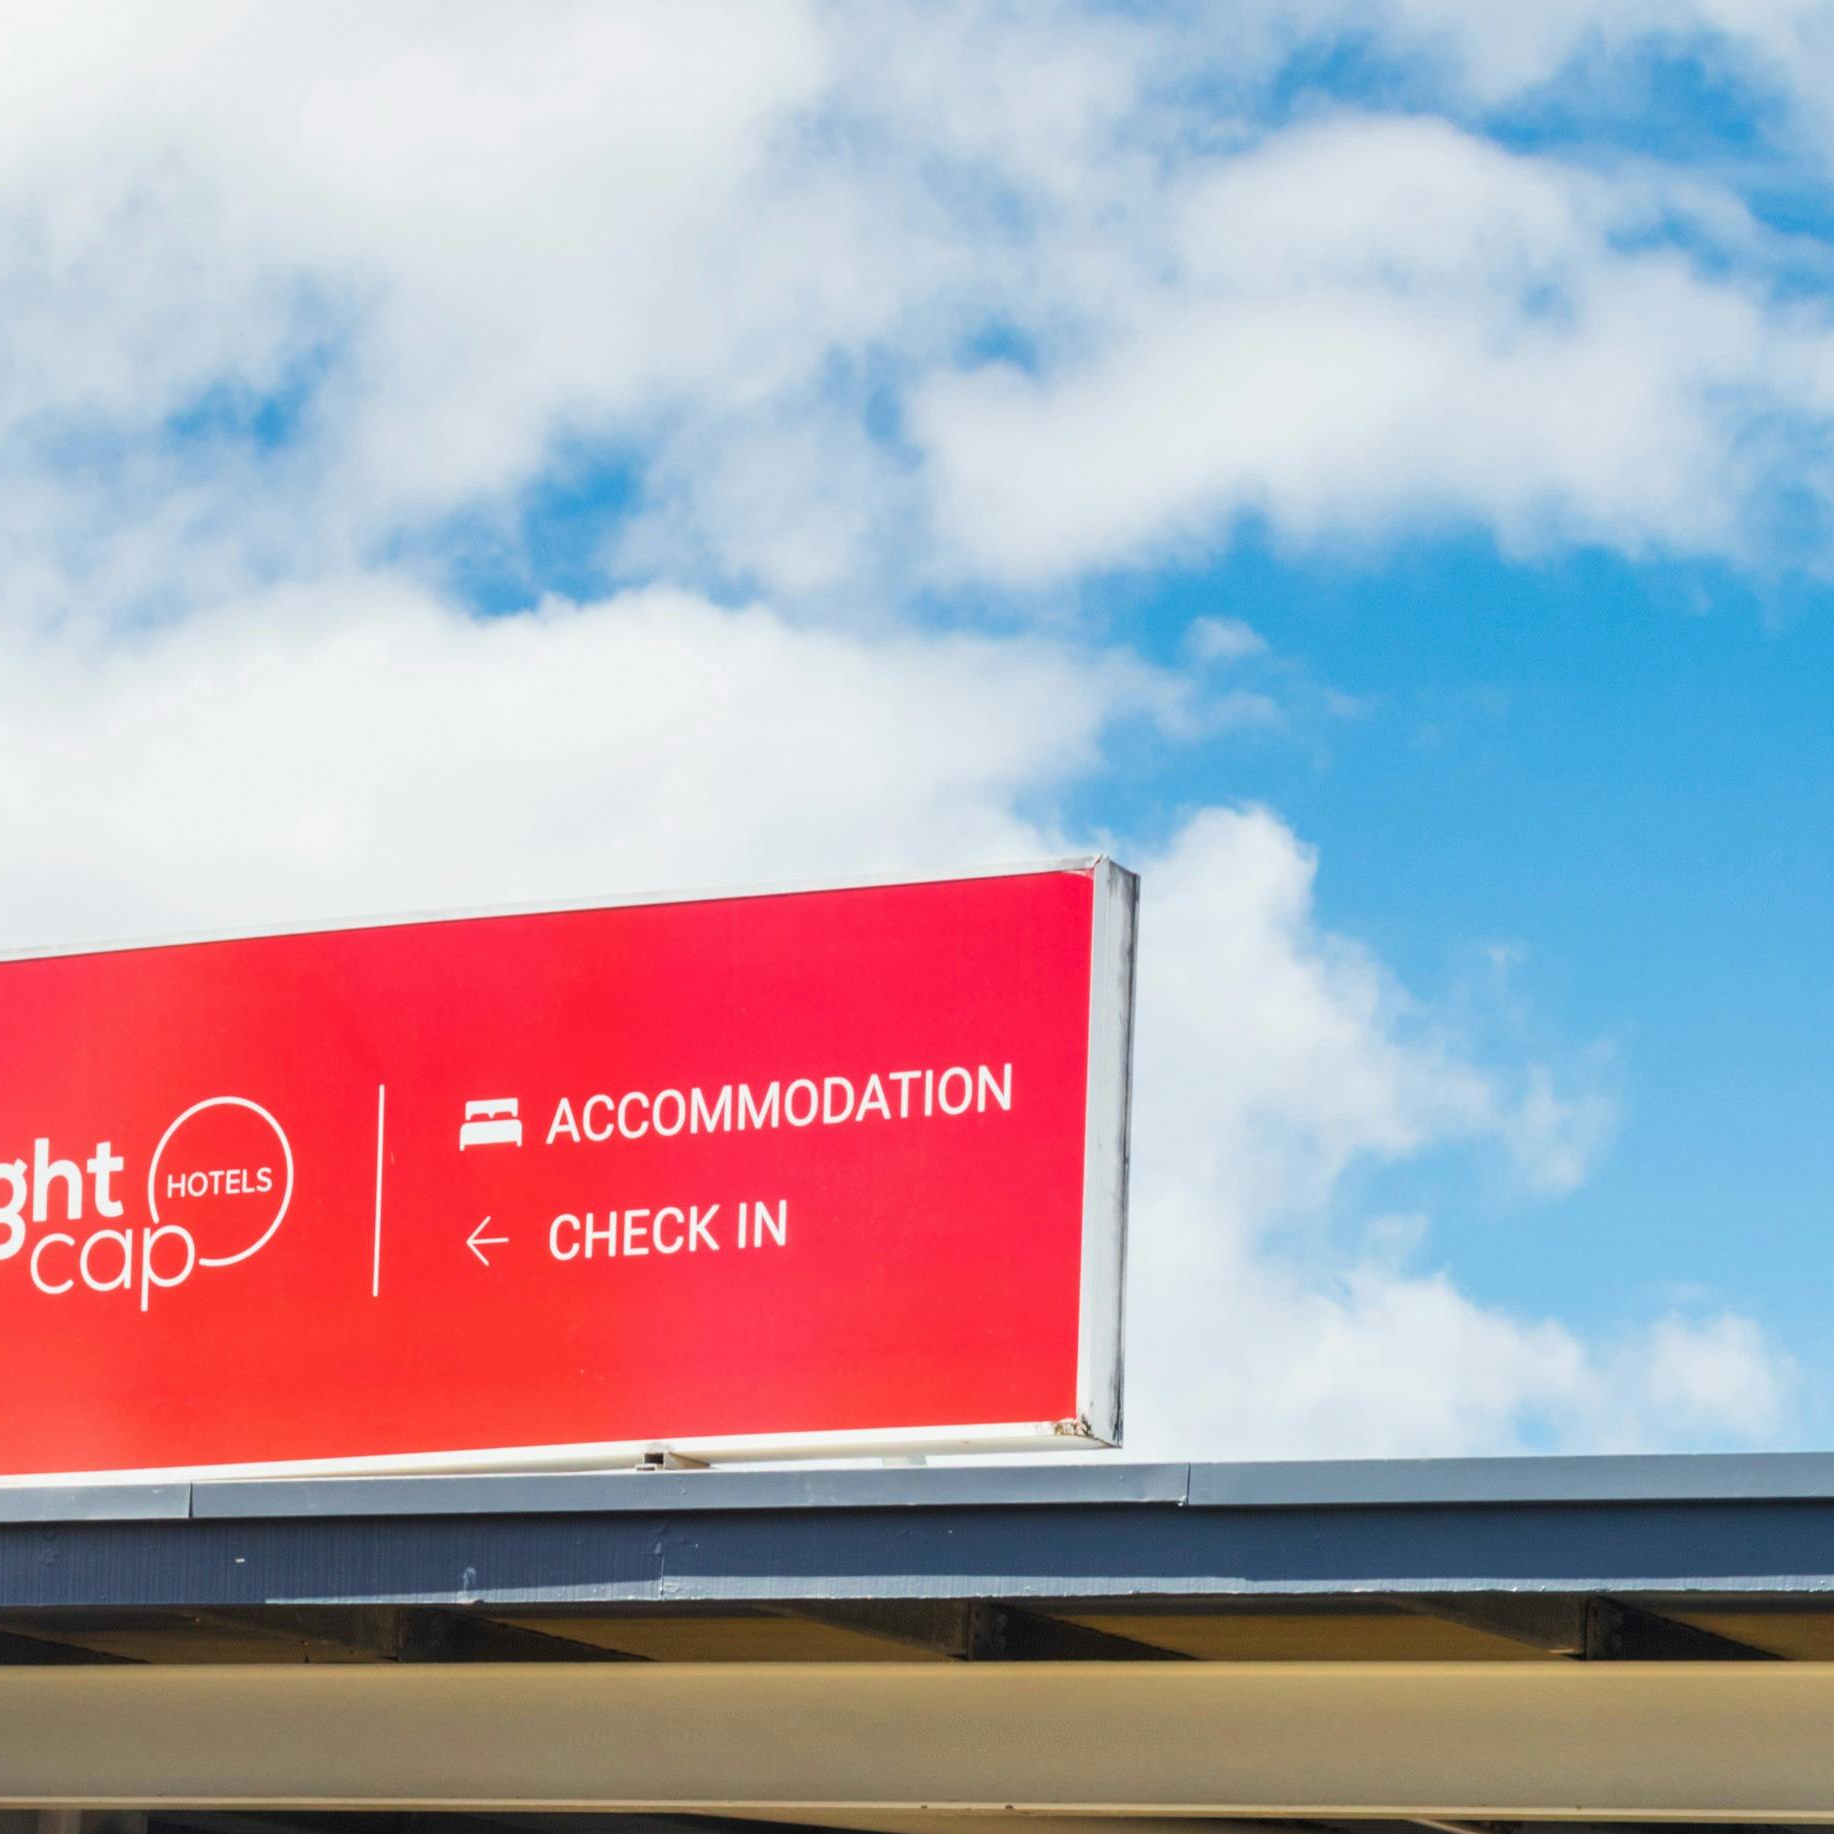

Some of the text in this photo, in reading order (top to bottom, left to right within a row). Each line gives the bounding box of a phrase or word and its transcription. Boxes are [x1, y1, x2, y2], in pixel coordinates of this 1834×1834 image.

[546, 1063, 1012, 1145] ACCOMMODATION
[167, 1167, 273, 1198] HOTELS
[549, 1199, 788, 1261] CHECK IN
[30, 1224, 196, 1313] cap
